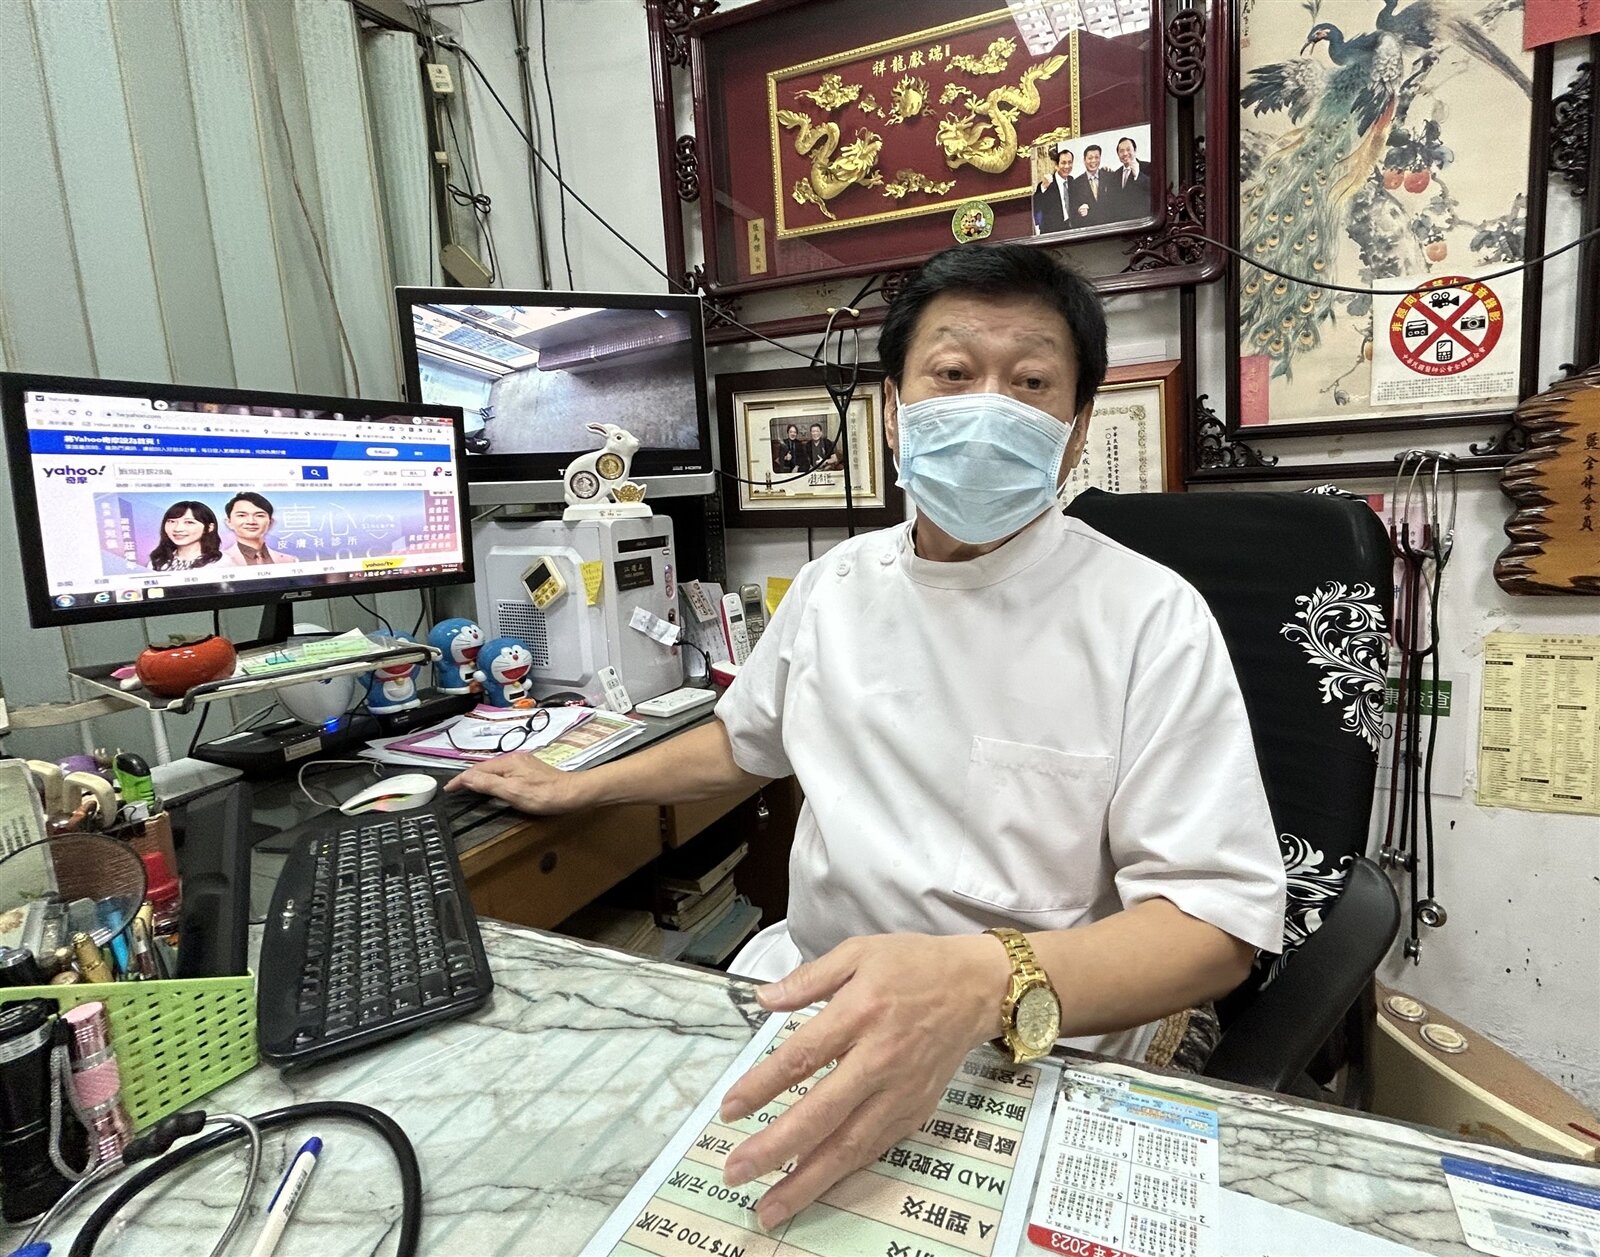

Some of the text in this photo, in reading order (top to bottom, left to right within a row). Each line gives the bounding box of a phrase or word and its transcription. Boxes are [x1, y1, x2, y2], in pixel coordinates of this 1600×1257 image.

[43, 465, 106, 478] yahoo!
[276, 502, 357, 540] 真心
[277, 536, 358, 550] 皮膚科診所
[280, 590, 313, 599] ASUS
[696, 1133, 735, 1156] 元/次
[918, 1118, 1018, 1157] 感冒疫苗/
[878, 1146, 1006, 1195] MAD 皮蛇疫
[667, 1169, 760, 1213] T$600 元/次
[635, 1210, 746, 1257] NT$700 元/次
[900, 1195, 995, 1239] A 型肝炎
[1051, 1232, 1088, 1255] 2023
